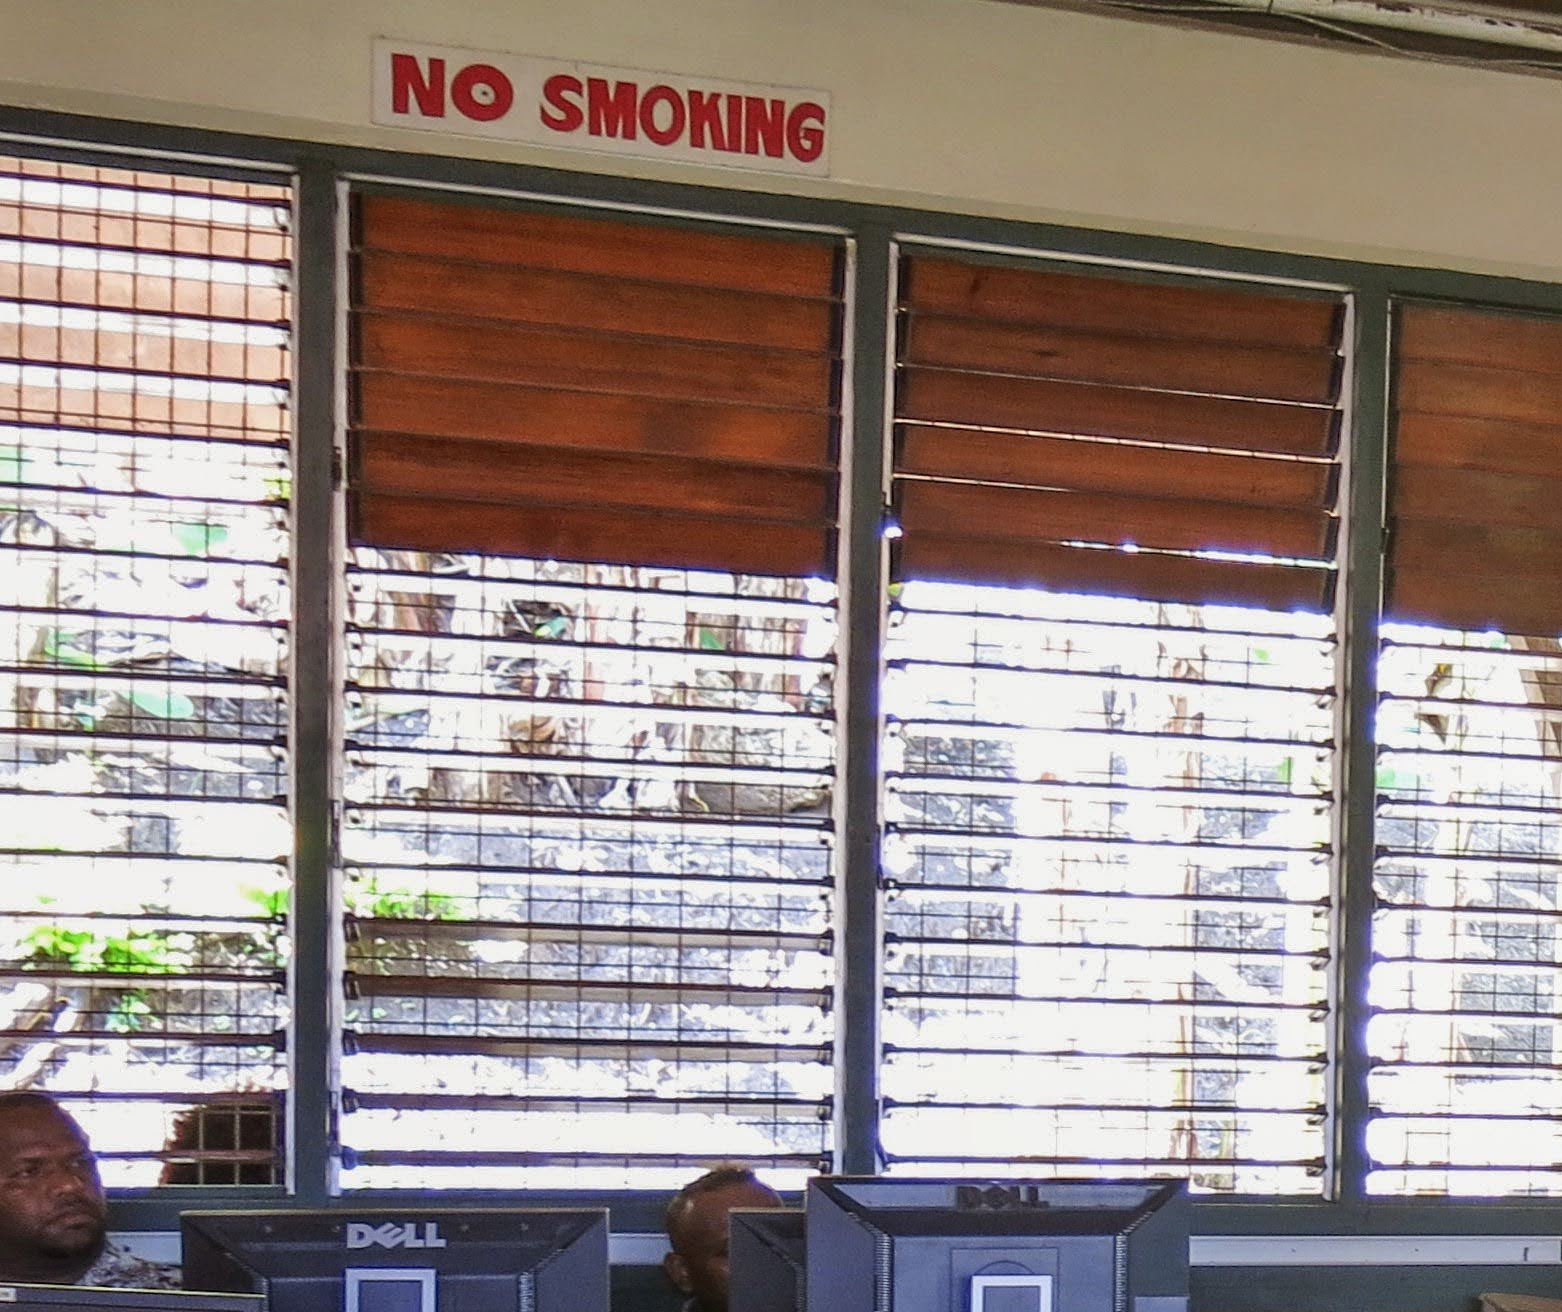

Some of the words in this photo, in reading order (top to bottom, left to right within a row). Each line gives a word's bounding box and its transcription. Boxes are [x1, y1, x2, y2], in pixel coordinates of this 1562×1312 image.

[391, 53, 514, 122] NO
[539, 74, 826, 163] SMOKING
[346, 1222, 447, 1249] DELL
